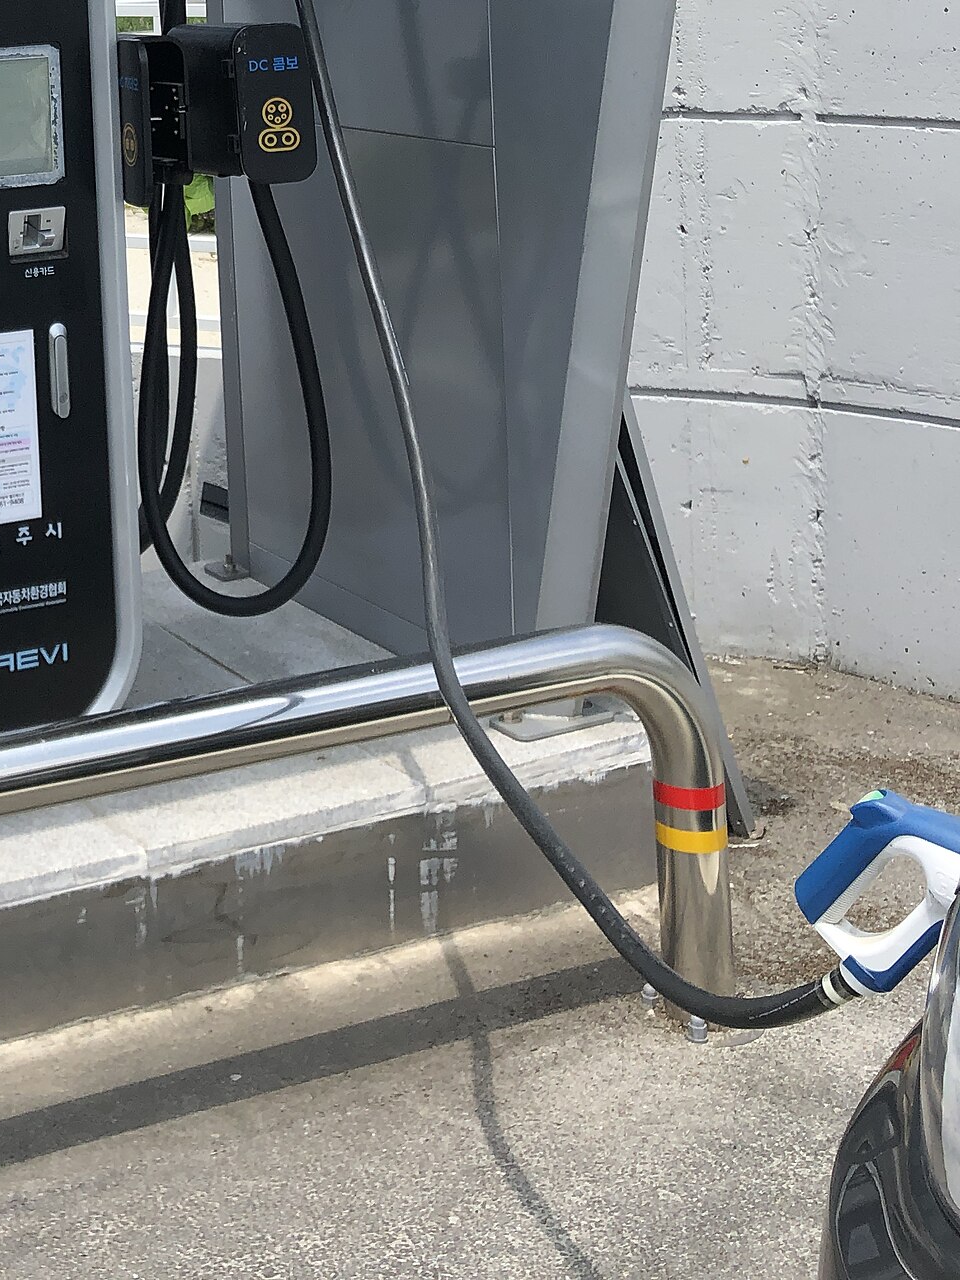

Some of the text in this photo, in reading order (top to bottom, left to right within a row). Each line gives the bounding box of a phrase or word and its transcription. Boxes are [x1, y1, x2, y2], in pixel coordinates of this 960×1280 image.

[248, 56, 299, 72] DC 콤보
[24, 266, 55, 279] 신용카드
